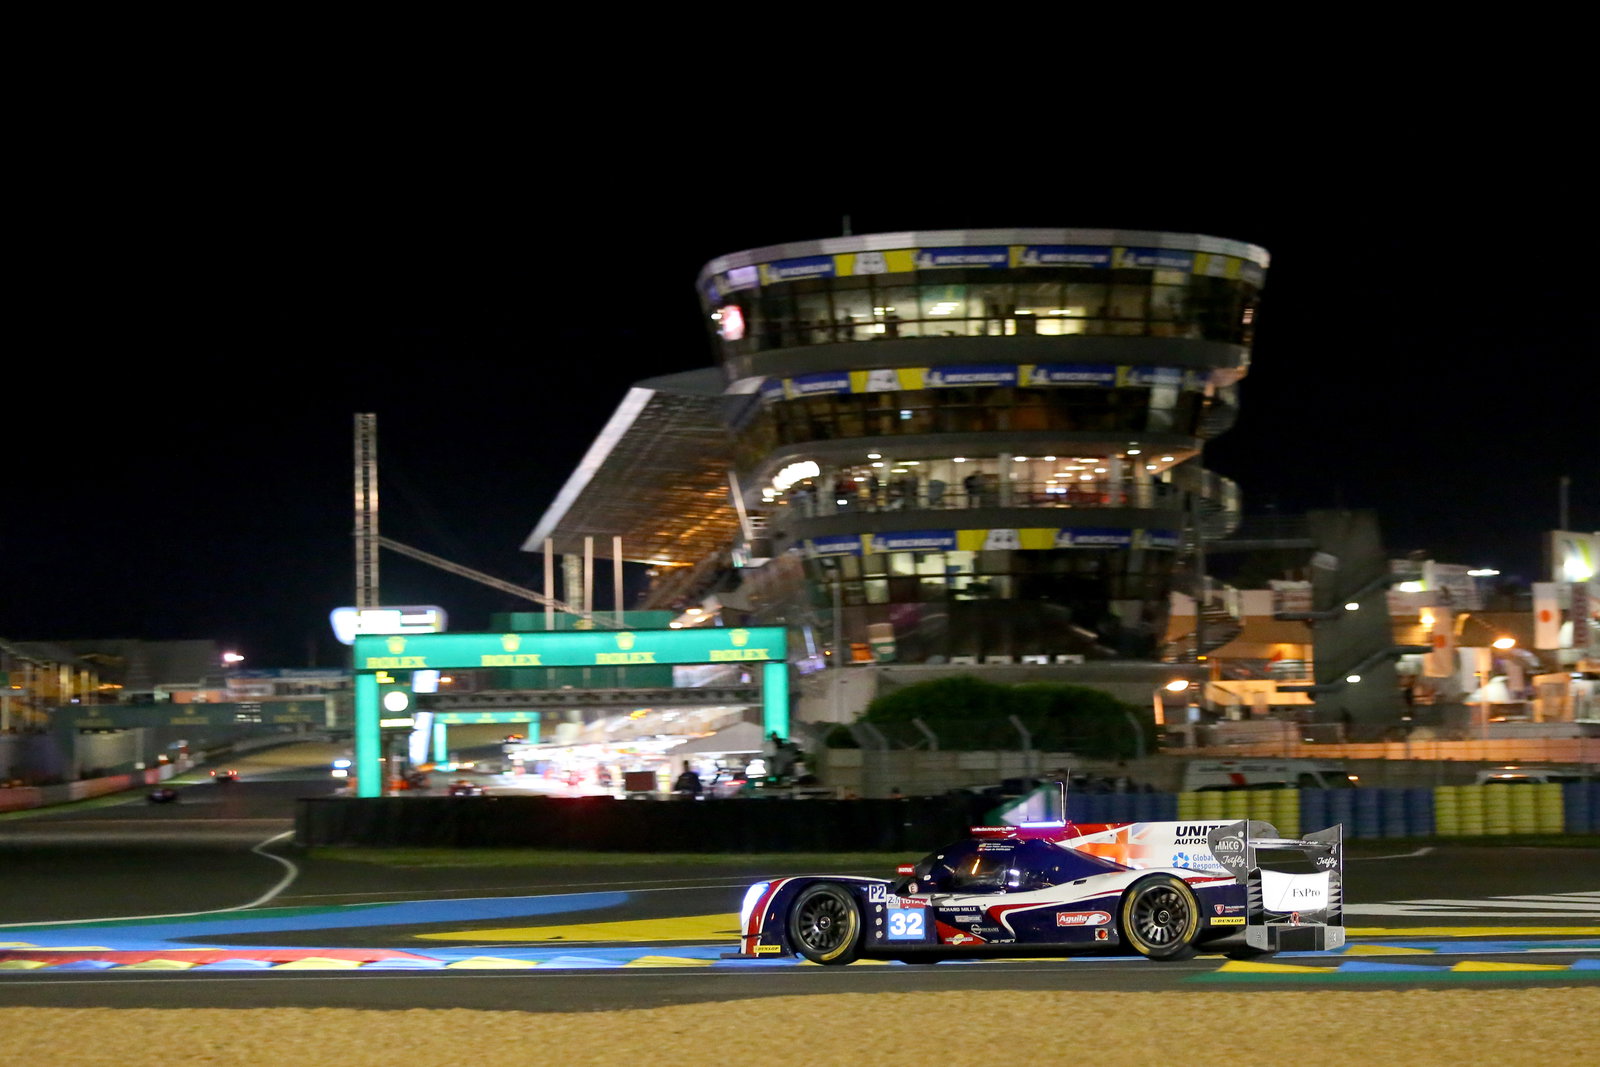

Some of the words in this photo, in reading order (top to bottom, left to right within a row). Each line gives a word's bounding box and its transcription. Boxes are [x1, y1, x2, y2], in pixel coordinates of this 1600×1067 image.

[481, 654, 543, 667] ROLEX
[595, 652, 656, 665] ROLEX
[709, 649, 771, 662] ROLEX
[366, 656, 429, 669] ROLEX
[1176, 825, 1230, 837] UNIT
[1193, 854, 1214, 862] Global
[1221, 855, 1246, 868] Jetfly
[1316, 857, 1338, 868] Jetfly
[871, 886, 885, 900] P2
[1292, 888, 1321, 898] FxPro
[890, 912, 923, 936] 32
[1059, 914, 1088, 924] Aguila
